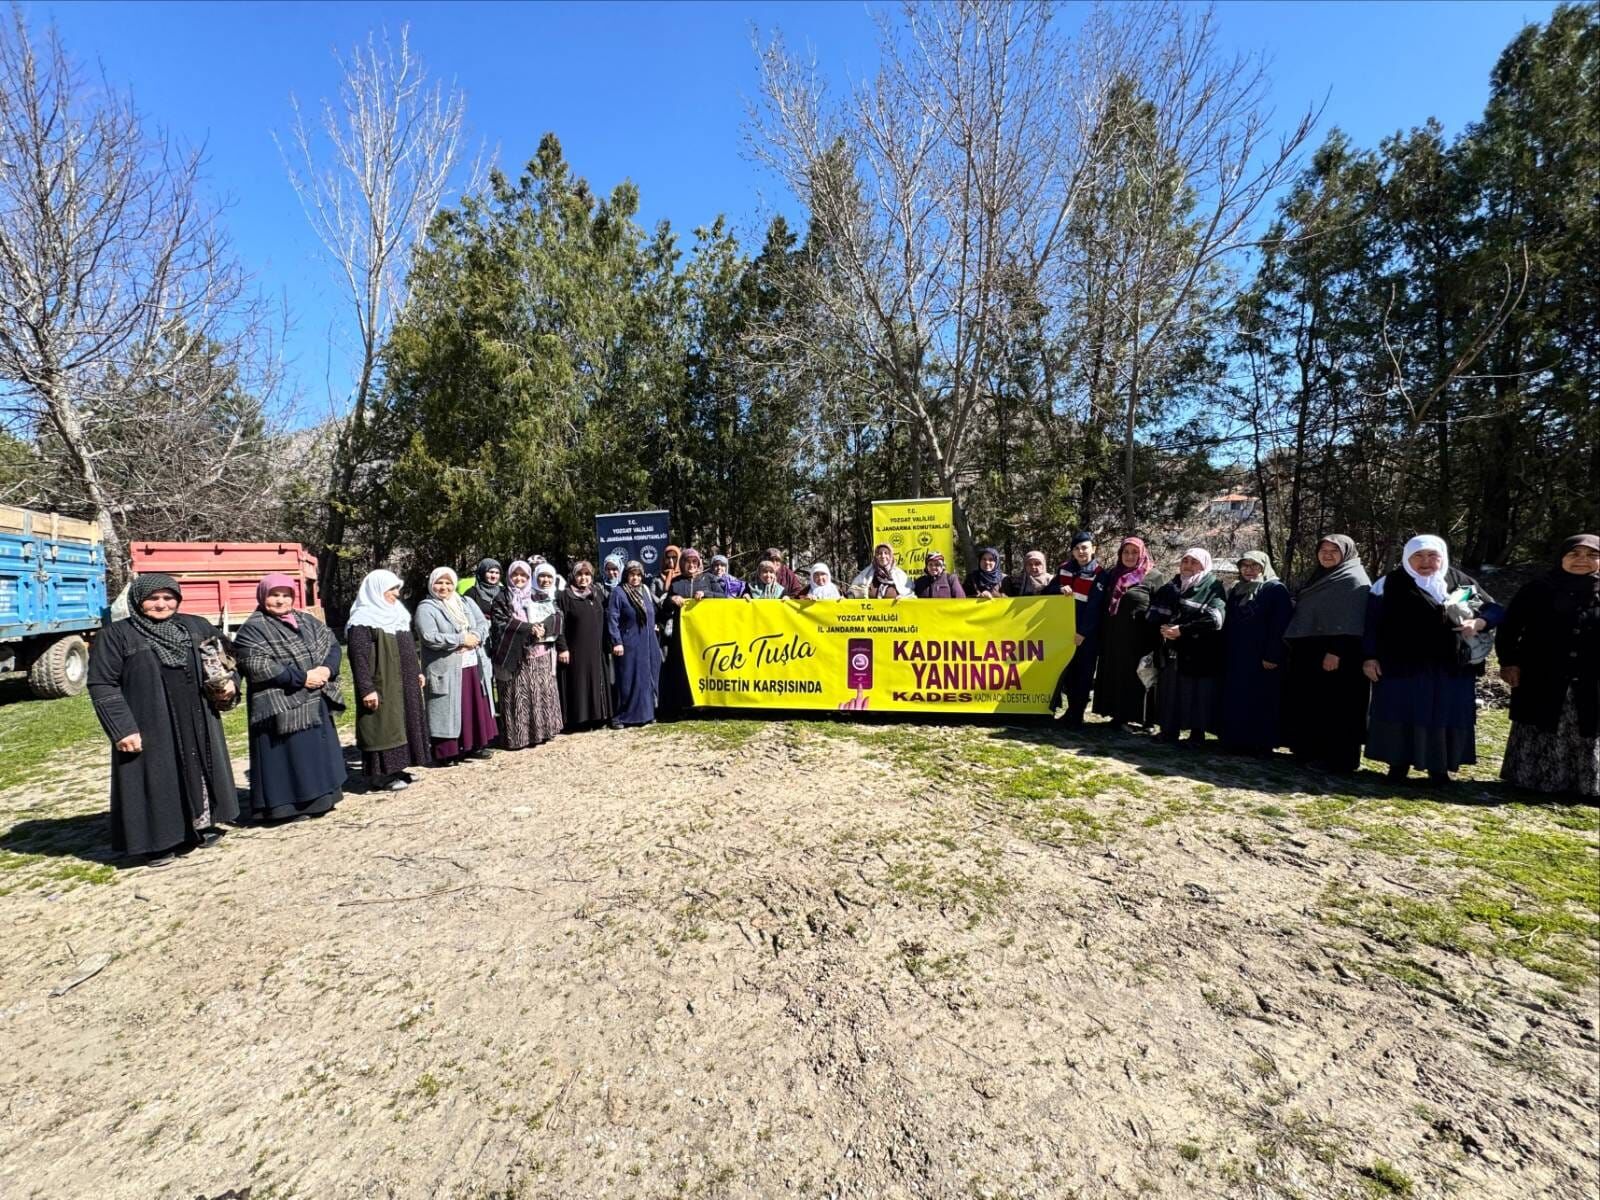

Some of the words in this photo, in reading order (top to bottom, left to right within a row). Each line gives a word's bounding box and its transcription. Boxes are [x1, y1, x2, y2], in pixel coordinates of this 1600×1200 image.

[867, 613, 898, 621] VALİLİĞİ
[867, 624, 918, 633] KOMUTANLIĞI
[702, 641, 747, 676] Tek
[748, 633, 817, 668] Tuşla
[893, 640, 1044, 661] KADINLARIN
[698, 676, 750, 693] ŞİDDETİN
[753, 679, 823, 696] KARŞISINDA
[911, 663, 1022, 690] YANINDA
[892, 691, 973, 703] KADES
[1007, 693, 1030, 703] DESTEK
